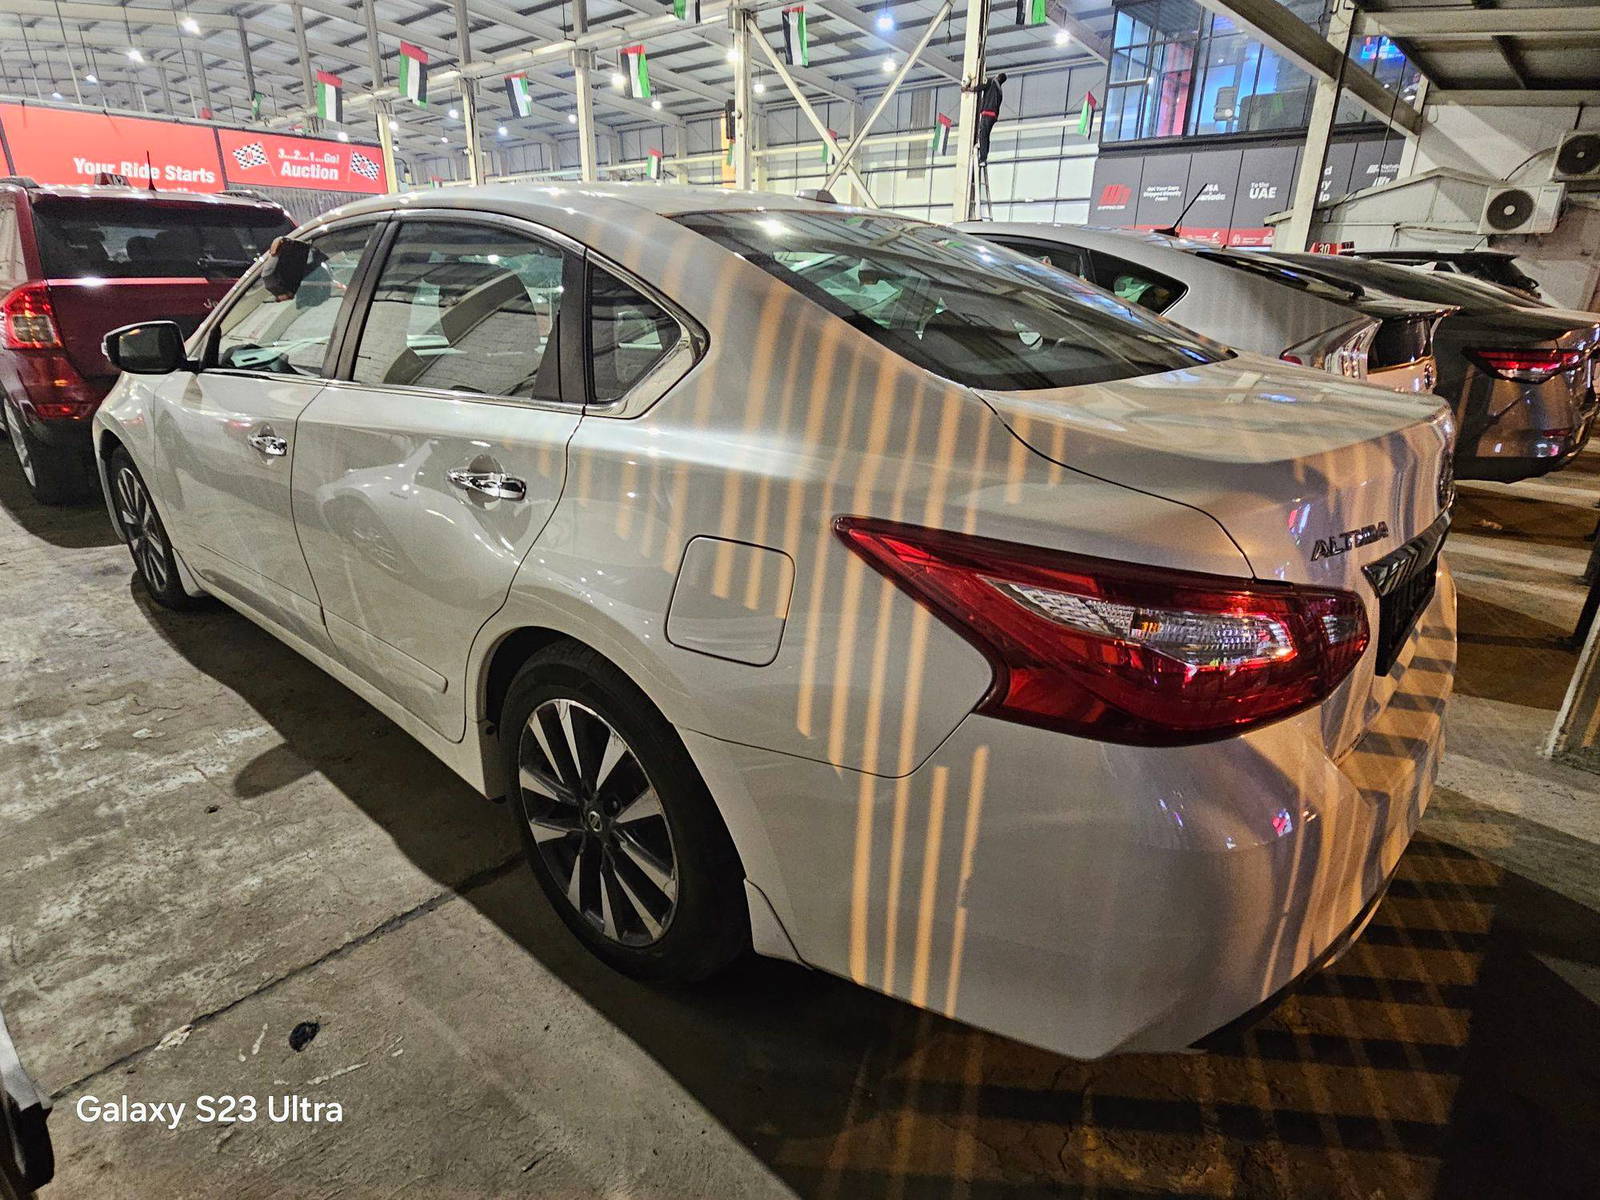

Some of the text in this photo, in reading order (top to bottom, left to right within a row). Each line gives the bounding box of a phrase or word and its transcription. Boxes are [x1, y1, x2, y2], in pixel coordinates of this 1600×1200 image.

[73, 157, 216, 184] Your Ride Starts
[281, 161, 339, 181] Auction
[1249, 187, 1278, 200] UAE
